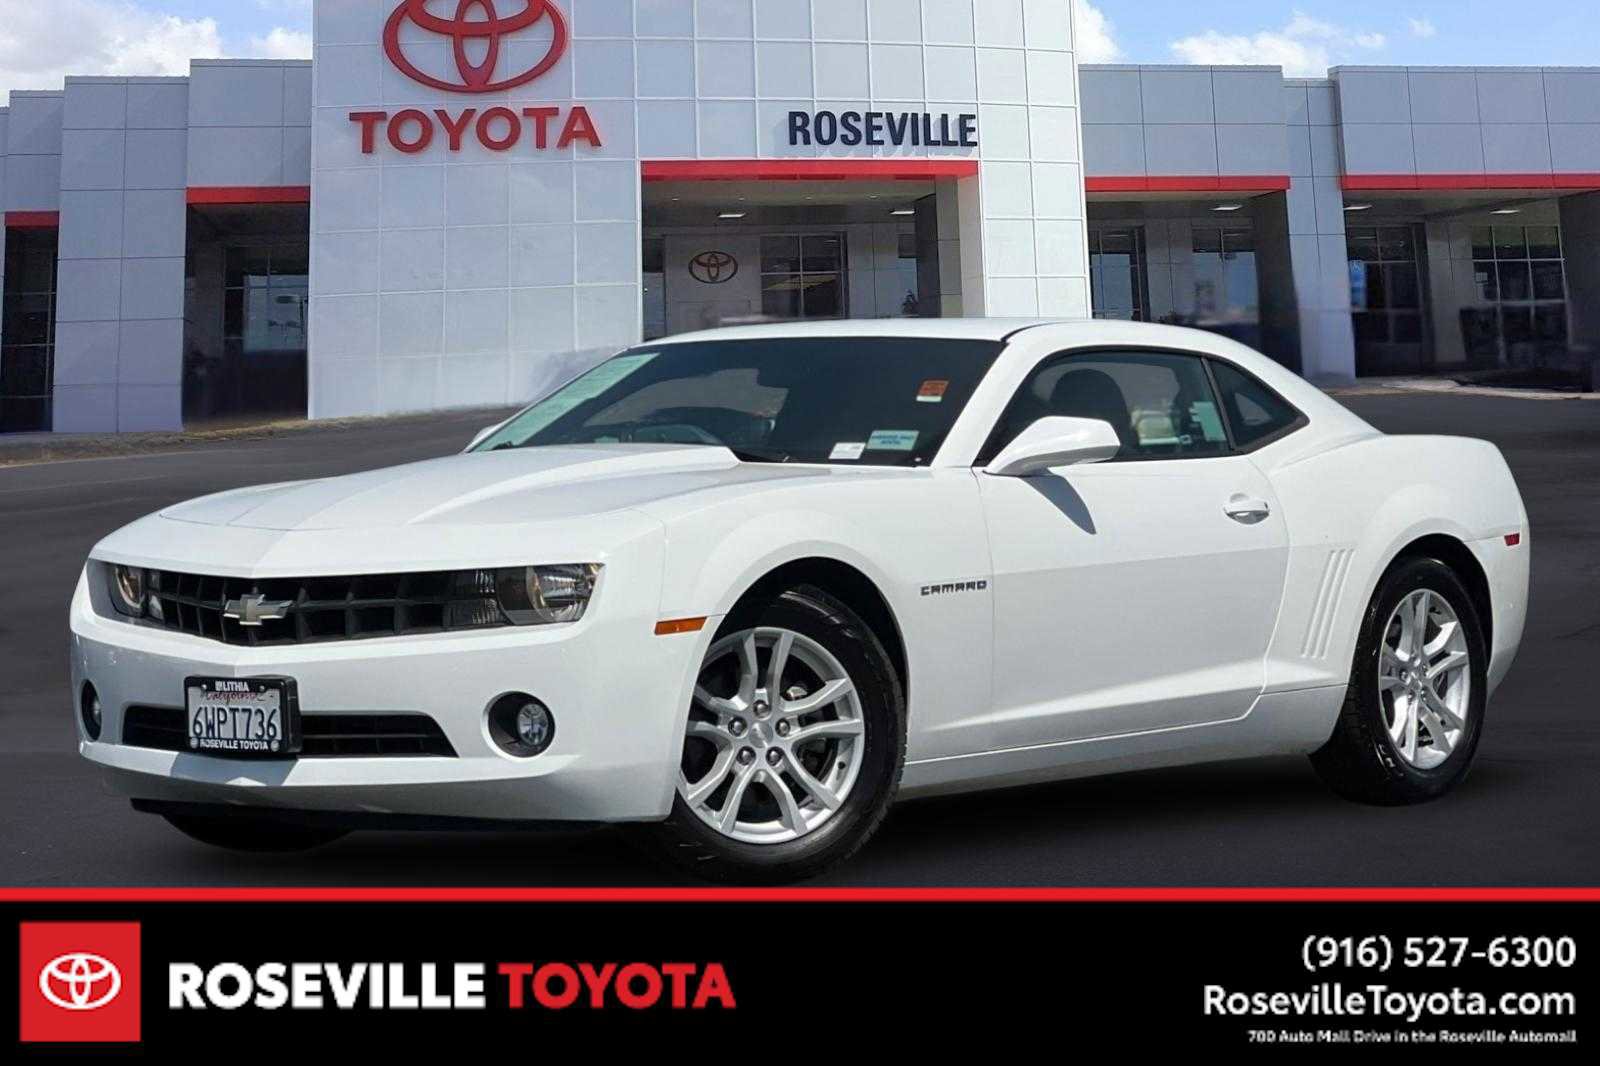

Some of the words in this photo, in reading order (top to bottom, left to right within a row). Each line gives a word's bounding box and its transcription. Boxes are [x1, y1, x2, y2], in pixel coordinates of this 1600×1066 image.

[349, 106, 602, 154] TOYOTA
[788, 110, 978, 147] ROSEVILLE
[920, 580, 987, 596] CAMARO
[223, 681, 250, 692] LITHIA
[192, 706, 278, 739] 6WPT736
[200, 739, 239, 749] ROSEVILLE
[239, 740, 269, 751] TOYOTA
